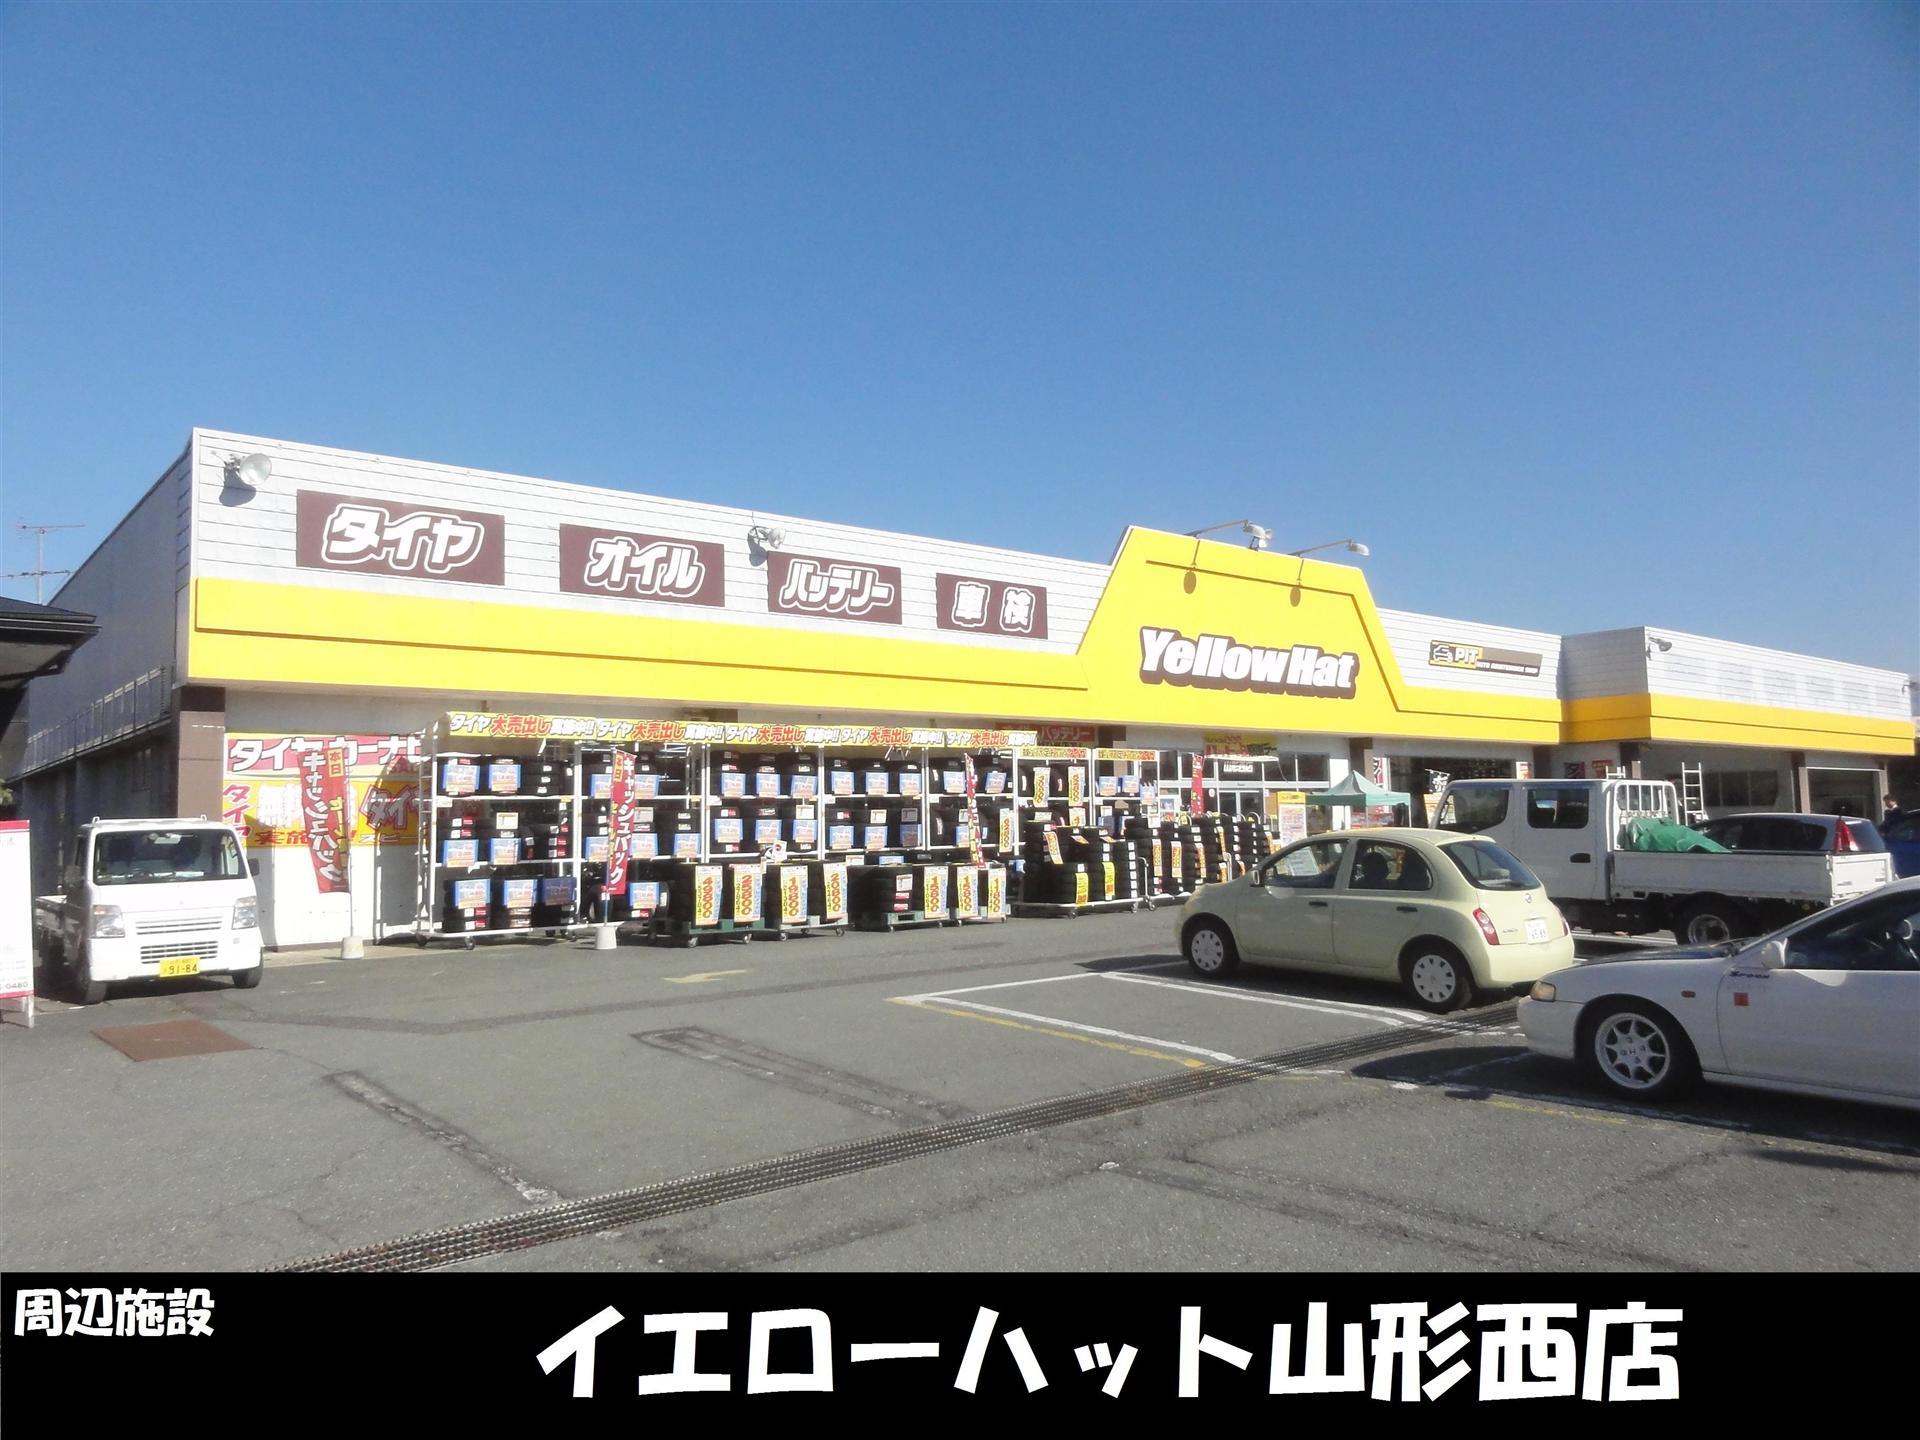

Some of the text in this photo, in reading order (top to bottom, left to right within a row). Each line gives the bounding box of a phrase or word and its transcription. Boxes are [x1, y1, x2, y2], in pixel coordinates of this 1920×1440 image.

[322, 504, 484, 573] タイヤ
[584, 537, 706, 597] オイル
[779, 559, 894, 615] バッテリー
[1455, 647, 1479, 665] PIT
[610, 757, 636, 885] キャッシュバック
